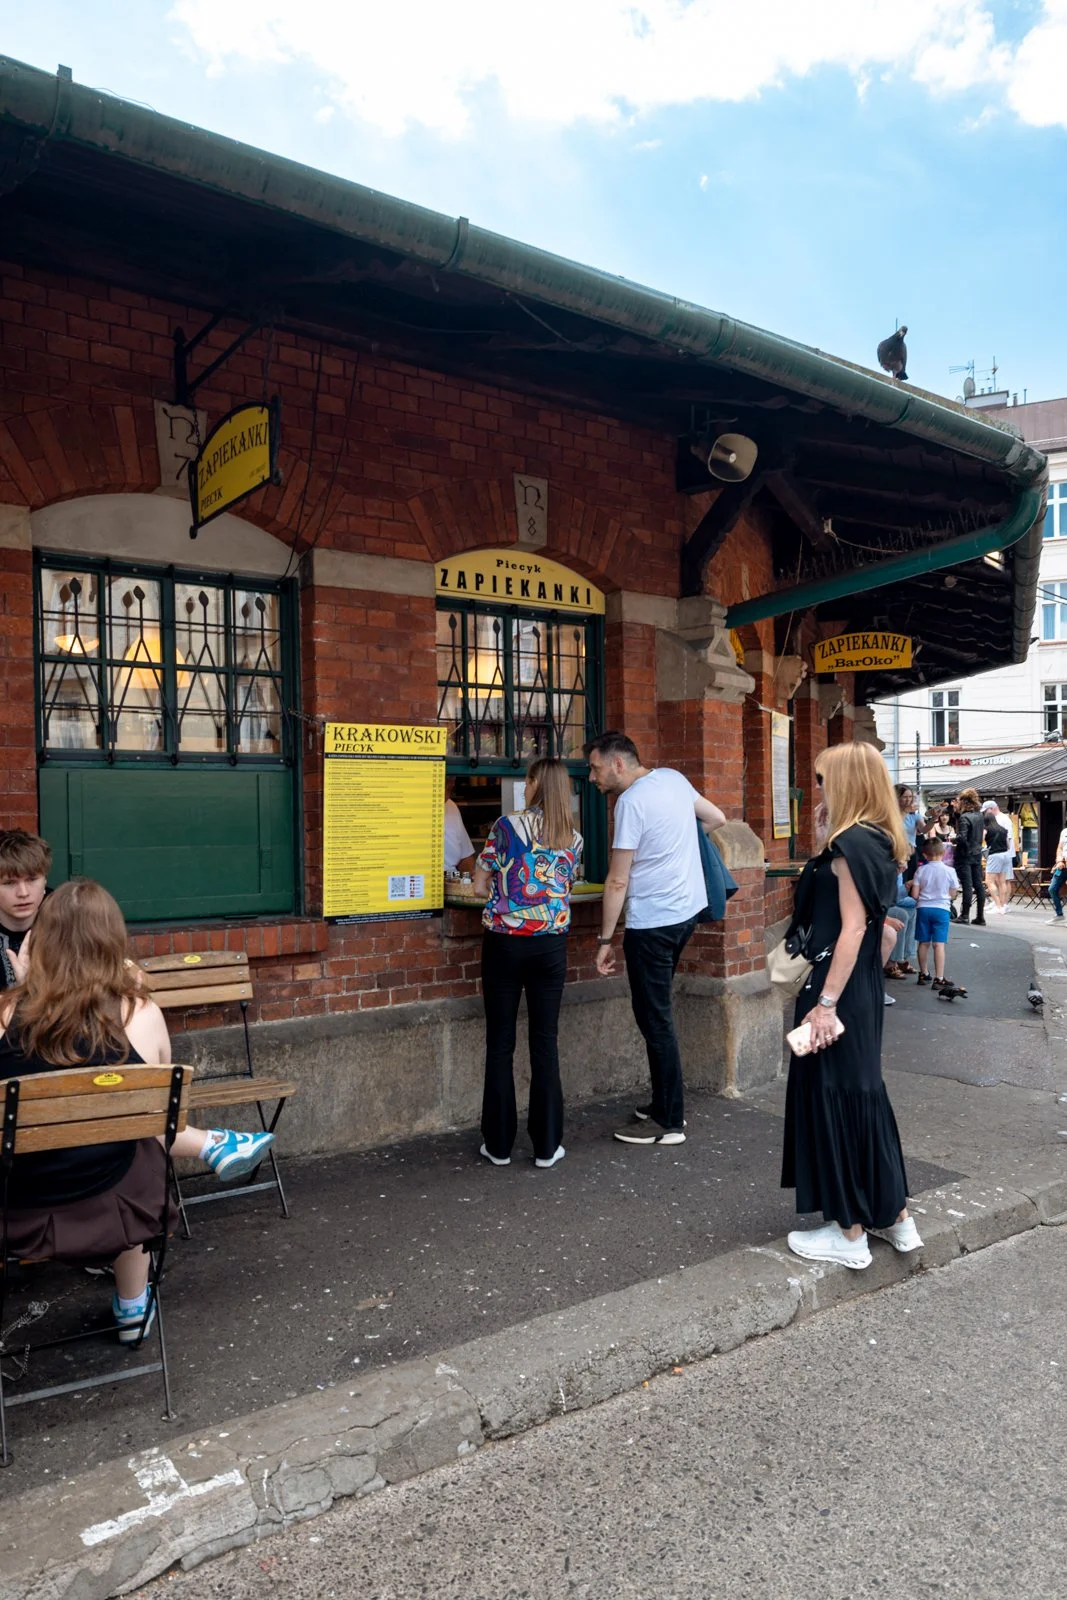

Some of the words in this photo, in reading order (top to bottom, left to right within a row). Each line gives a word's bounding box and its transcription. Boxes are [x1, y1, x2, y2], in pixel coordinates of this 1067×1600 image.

[174, 452, 191, 480] 7
[199, 422, 269, 490] ZAPIEKANKI
[200, 486, 224, 512] PIECYK
[527, 516, 537, 536] 8
[496, 559, 542, 574] Piecyk
[440, 568, 591, 605] ZAPIEKANKI
[818, 633, 908, 660] ZAPIEKANKI
[333, 726, 441, 744] KRAKOWSKI
[334, 743, 375, 753] PIECYK
[904, 759, 949, 767] KOHANKA
